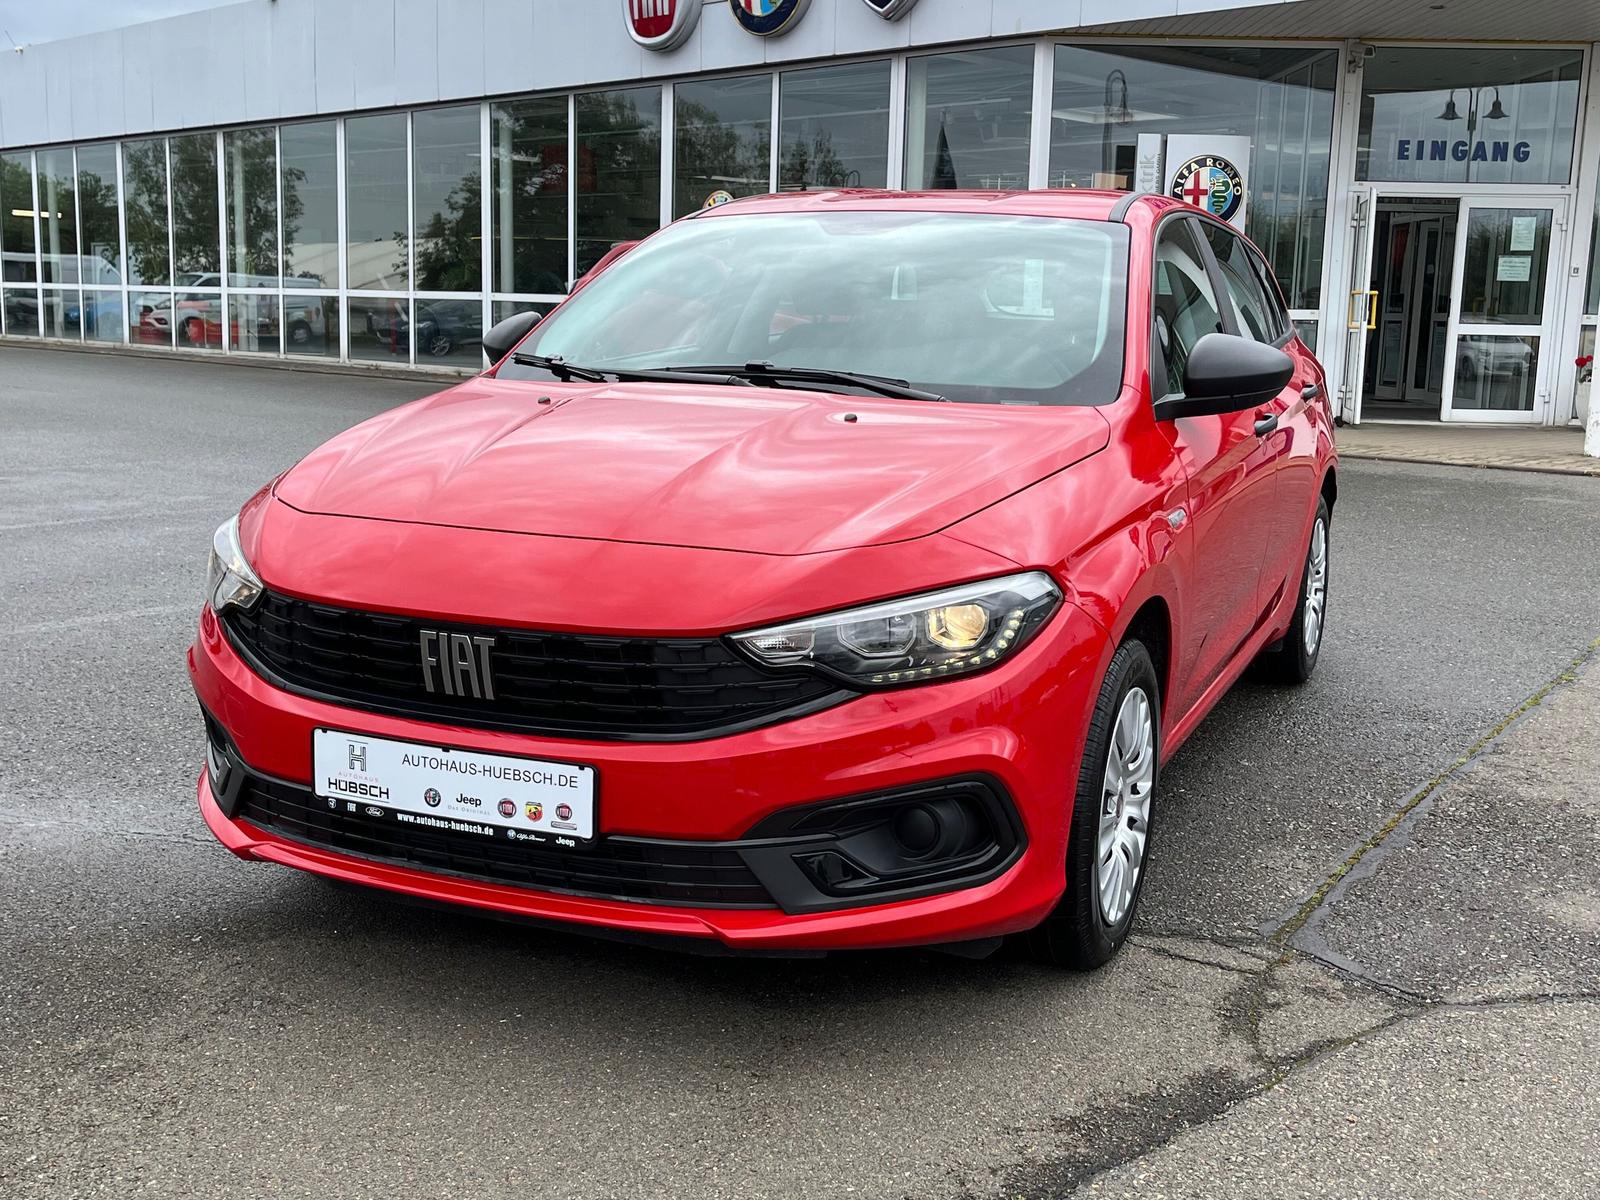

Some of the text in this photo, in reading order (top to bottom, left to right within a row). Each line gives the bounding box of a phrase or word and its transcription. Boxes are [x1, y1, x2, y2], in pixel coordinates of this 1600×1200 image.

[1397, 139, 1531, 163] EINGANG
[1174, 158, 1242, 196] ALFA ROMEO
[420, 629, 495, 700] FIAT
[338, 770, 379, 783] AUTOHAUS
[401, 753, 579, 789] AUTOHAUS-HUEBSCH.DE
[328, 777, 389, 799] HÜBSCH
[456, 793, 482, 807] Jeep
[396, 812, 494, 836] www.autohaus-huebsch.de
[555, 836, 576, 847] Jeep
